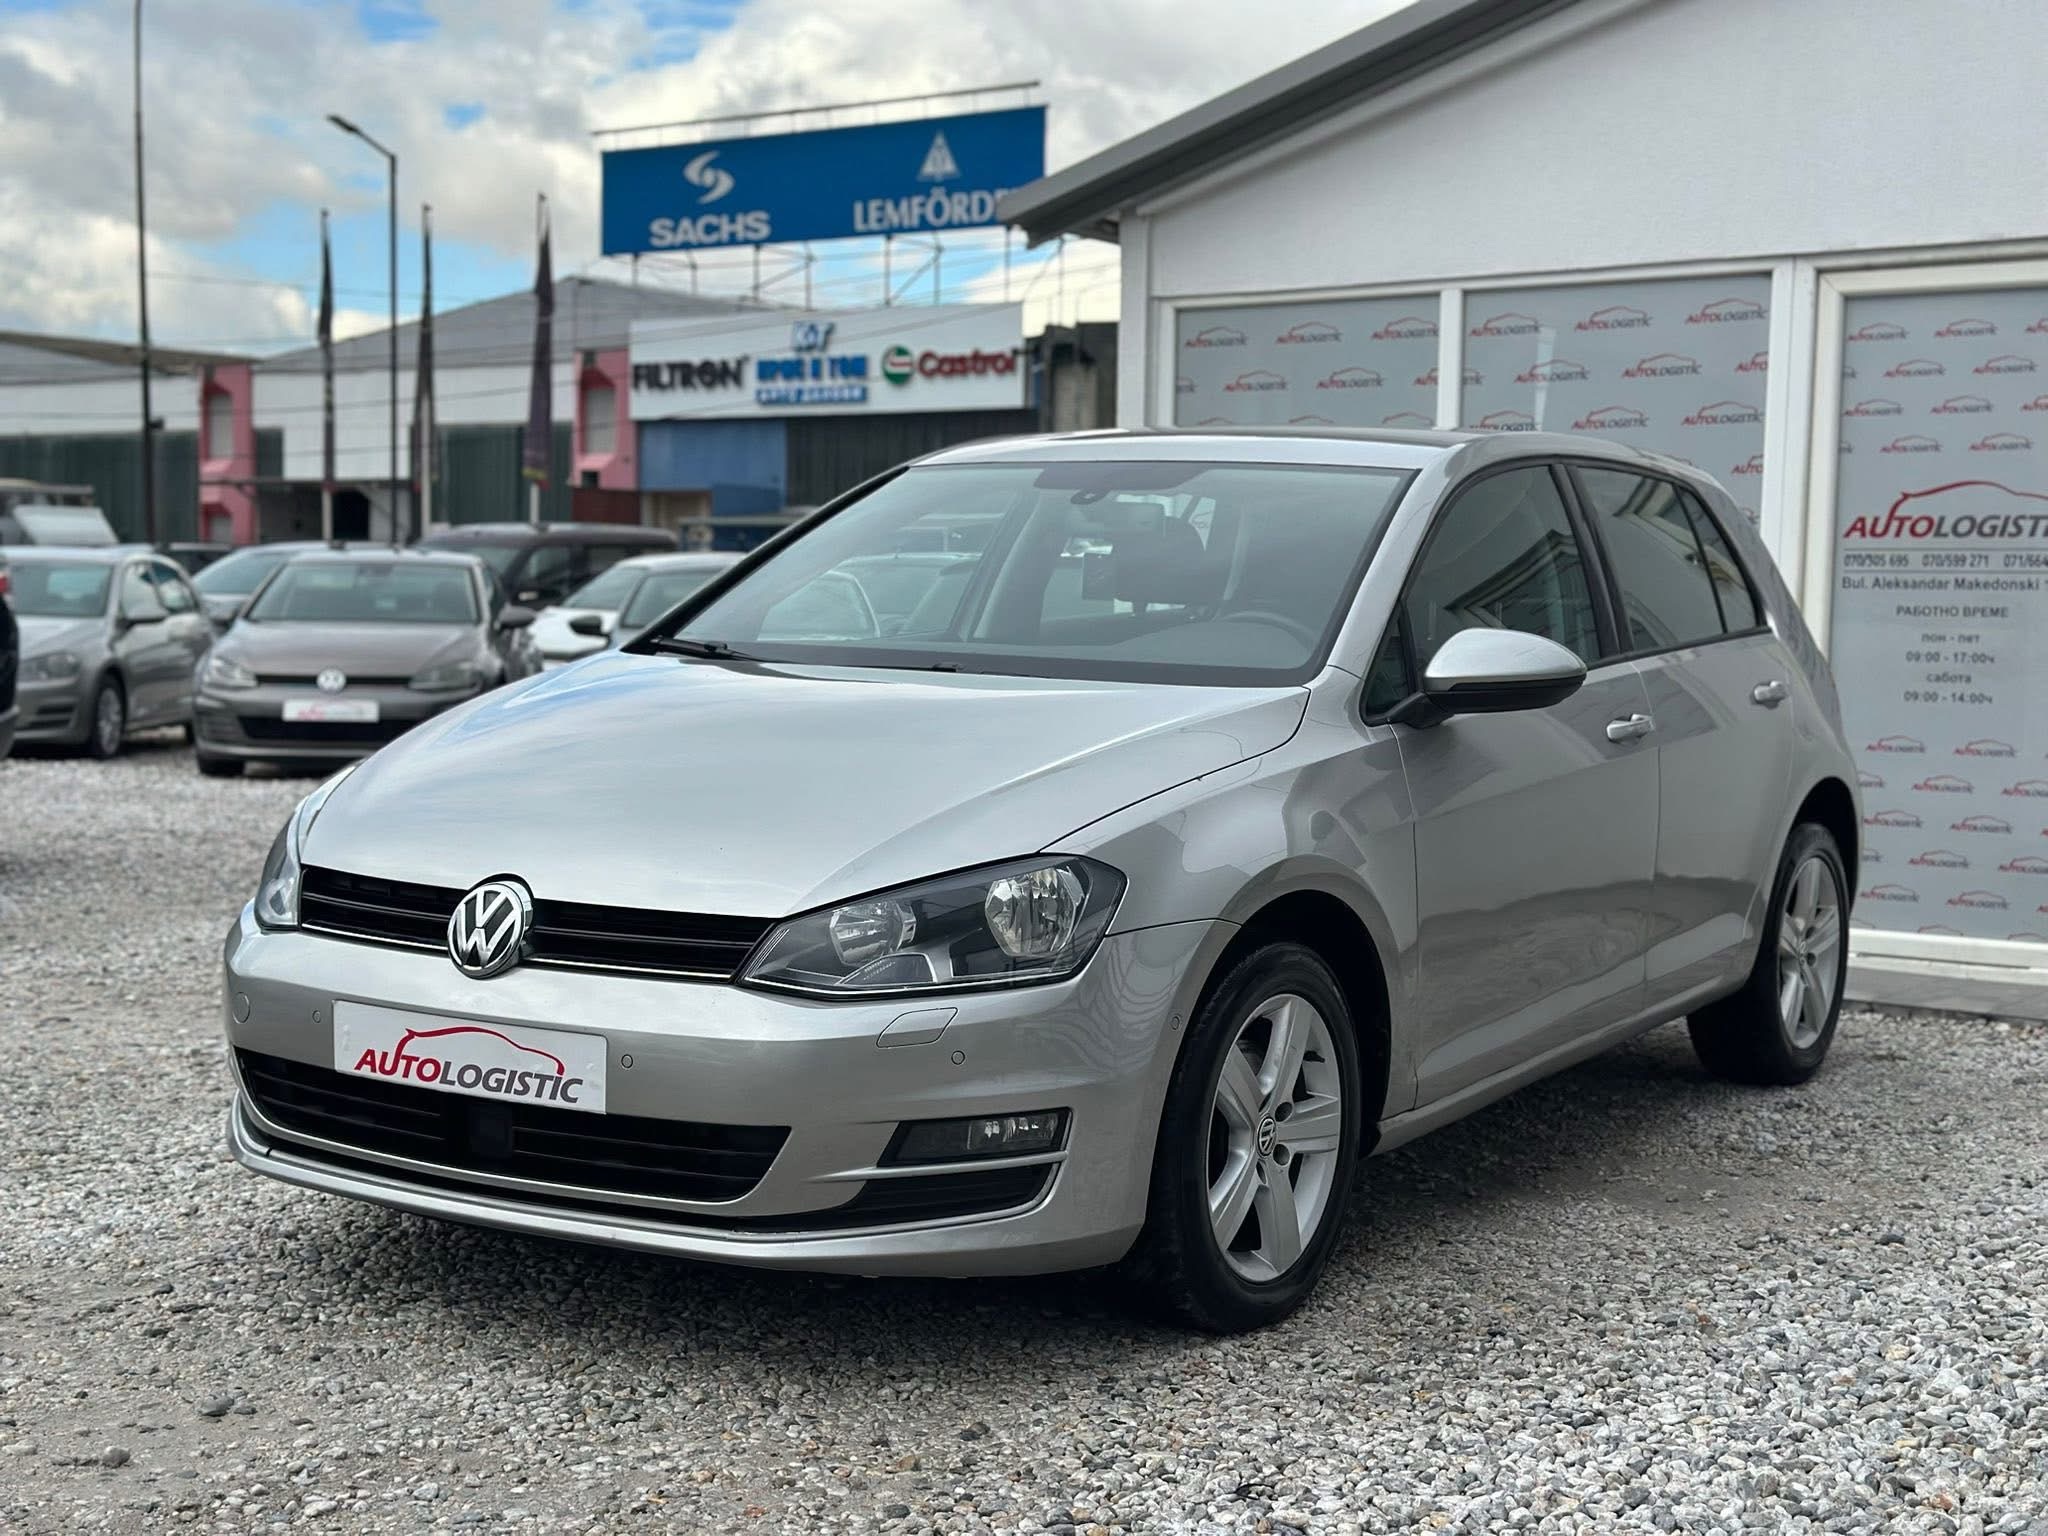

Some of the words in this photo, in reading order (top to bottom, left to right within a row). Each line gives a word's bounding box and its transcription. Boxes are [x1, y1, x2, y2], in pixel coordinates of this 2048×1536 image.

[649, 210, 771, 247] SACHS
[918, 348, 1017, 379] Castrol
[632, 357, 744, 392] FILTRON
[1842, 576, 1867, 591] Bul.
[1872, 576, 1950, 591] Aleksandar
[1954, 577, 2040, 592] Makedonski
[1896, 605, 1959, 618] РАБОТНО
[1962, 606, 2008, 619] ВРЕМЕ
[1905, 651, 1941, 663] 09:00
[1926, 671, 1972, 684] сабота
[1904, 690, 1939, 703] 09:00
[354, 1047, 584, 1104] AUTOLOGISTIC
